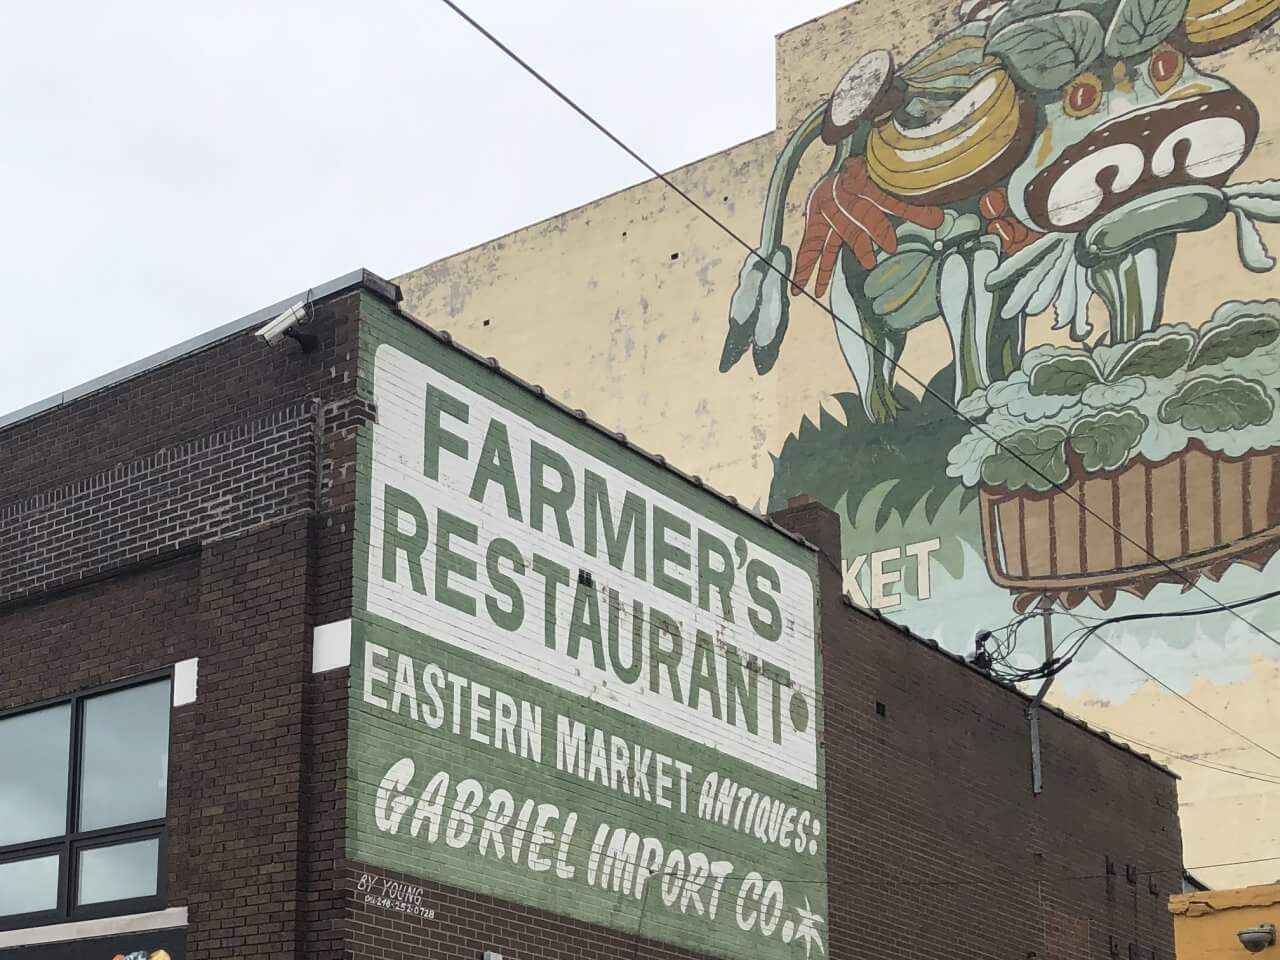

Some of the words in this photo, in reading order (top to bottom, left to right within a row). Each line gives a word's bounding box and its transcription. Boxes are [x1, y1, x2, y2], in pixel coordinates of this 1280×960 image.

[422, 382, 783, 643] FARMER'S
[363, 641, 543, 763] EASTERN
[556, 714, 693, 814] MARKET
[357, 874, 378, 892] BY
[382, 879, 424, 905] YOUNG
[375, 757, 578, 879] GABRIEL
[587, 822, 734, 922] IMPORT
